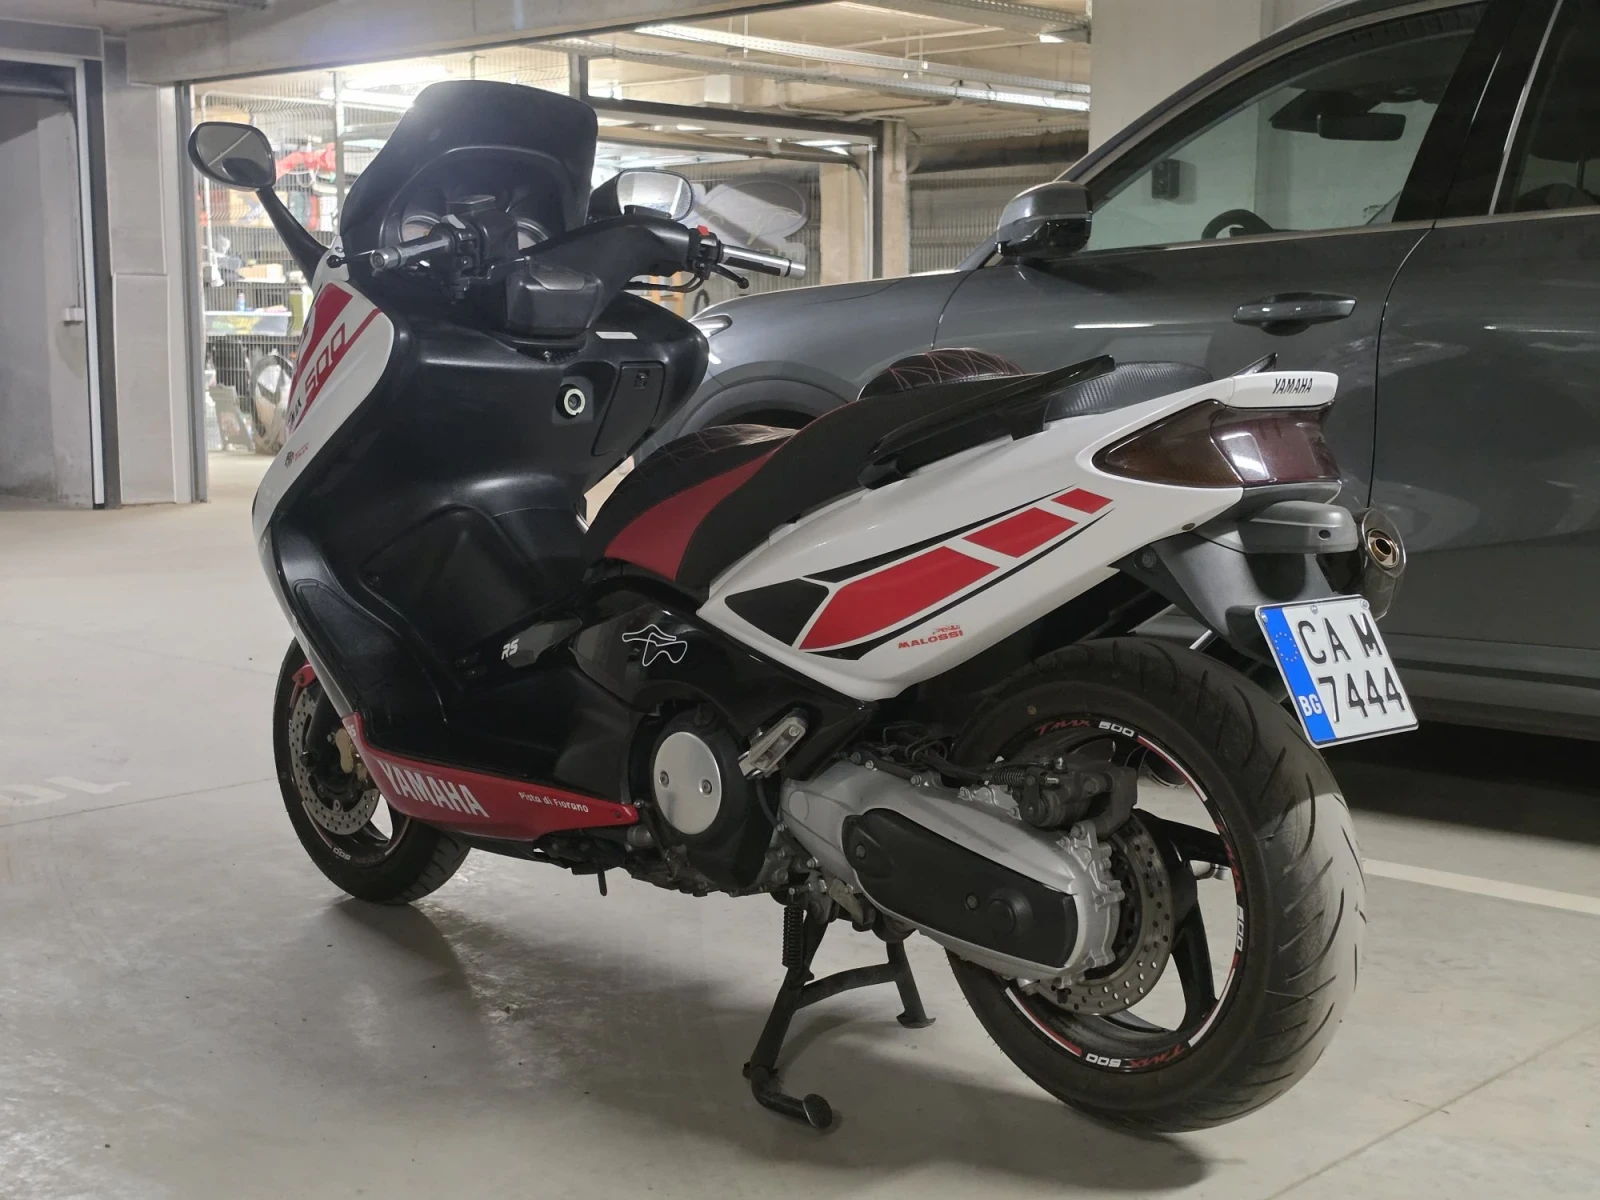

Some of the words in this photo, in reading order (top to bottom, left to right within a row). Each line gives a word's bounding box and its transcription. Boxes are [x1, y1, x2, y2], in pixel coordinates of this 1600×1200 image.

[1272, 378, 1313, 394] YAMAHA
[501, 638, 520, 660] RS
[898, 630, 964, 649] MALOSSI
[1297, 617, 1351, 665] CA
[1349, 612, 1383, 658] M
[1298, 694, 1323, 717] BG
[1317, 666, 1406, 724] 7444
[1098, 720, 1136, 738] 500
[377, 760, 490, 818] YAMAHA
[519, 791, 542, 804] Pista
[543, 795, 553, 806] di
[553, 798, 589, 813] Fiorano
[333, 846, 352, 861] 500
[1085, 1052, 1122, 1068] 500
